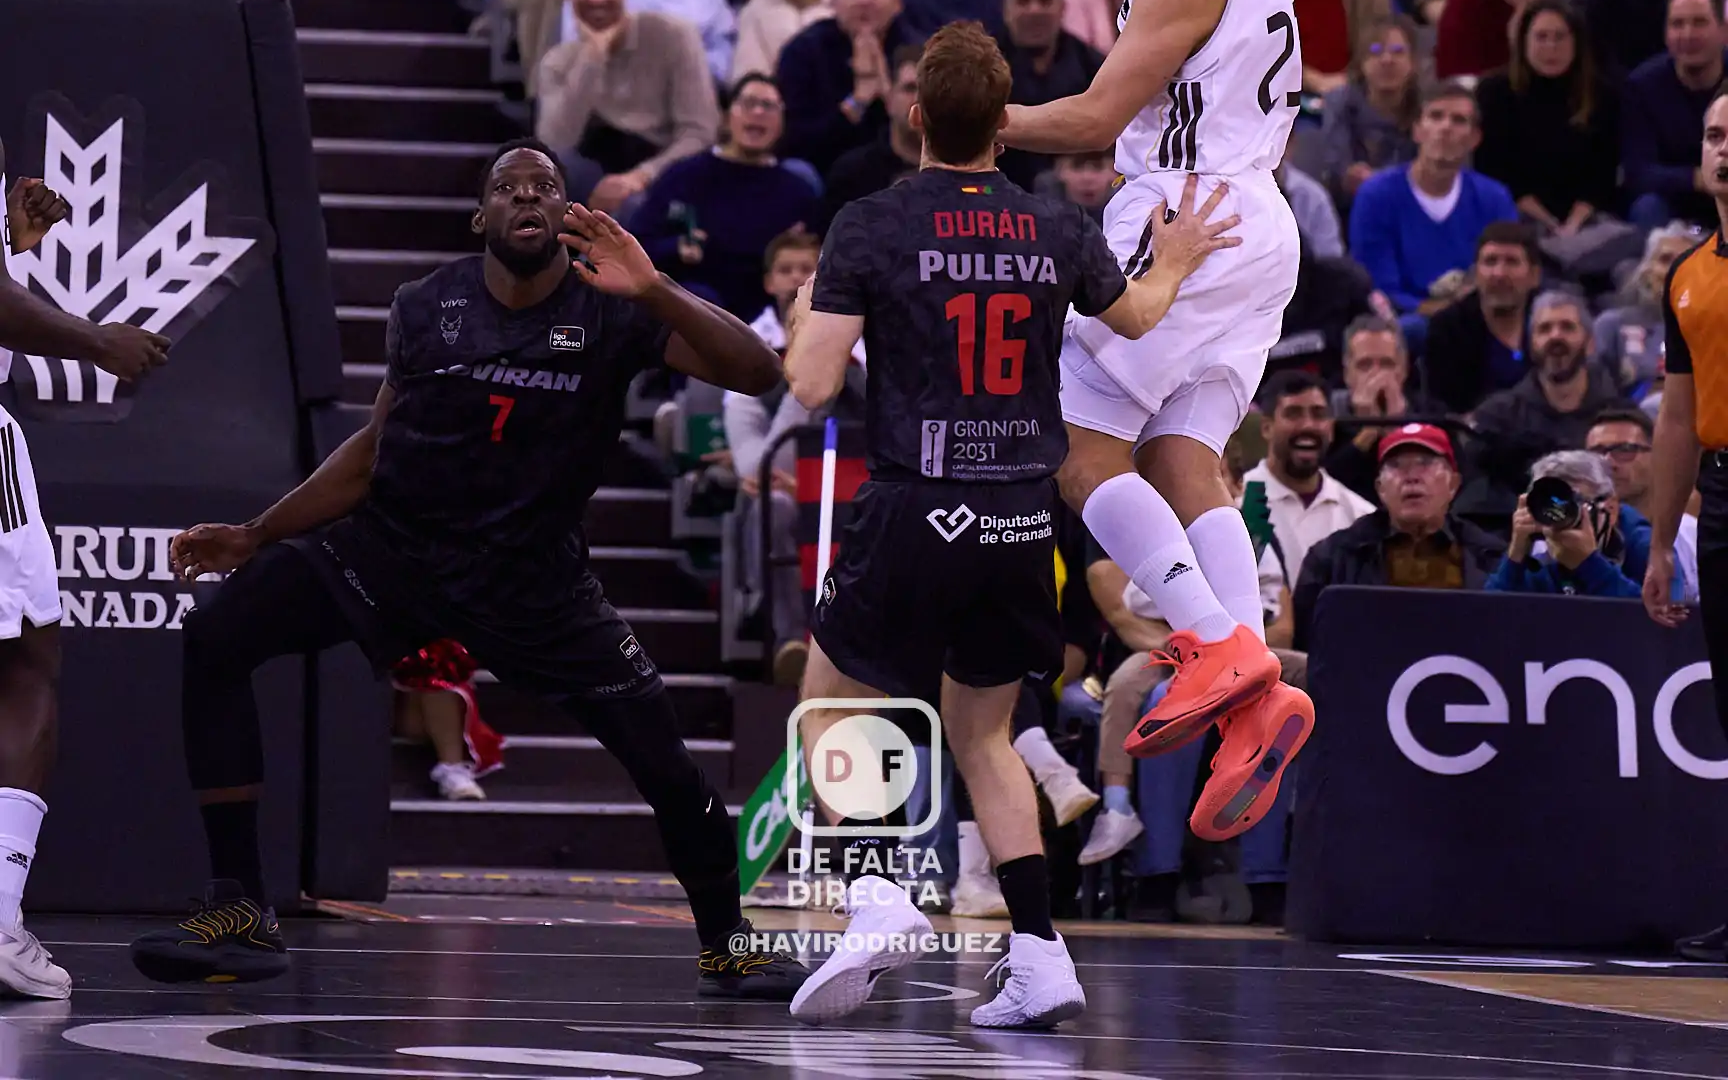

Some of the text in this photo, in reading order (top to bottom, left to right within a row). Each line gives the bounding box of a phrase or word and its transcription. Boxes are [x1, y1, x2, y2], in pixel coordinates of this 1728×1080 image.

[934, 208, 1037, 241] DURÁN
[918, 249, 1058, 285] PULEVA
[552, 340, 581, 348] endesa
[553, 332, 567, 340] liga
[944, 292, 1032, 396] 16
[489, 392, 516, 443] 7
[953, 419, 1041, 438] GRANADA
[952, 442, 997, 462] 2031
[980, 509, 1051, 531] Diputación
[979, 525, 1052, 544] de Granada
[1163, 566, 1193, 584] adidas
[625, 644, 637, 656] acb
